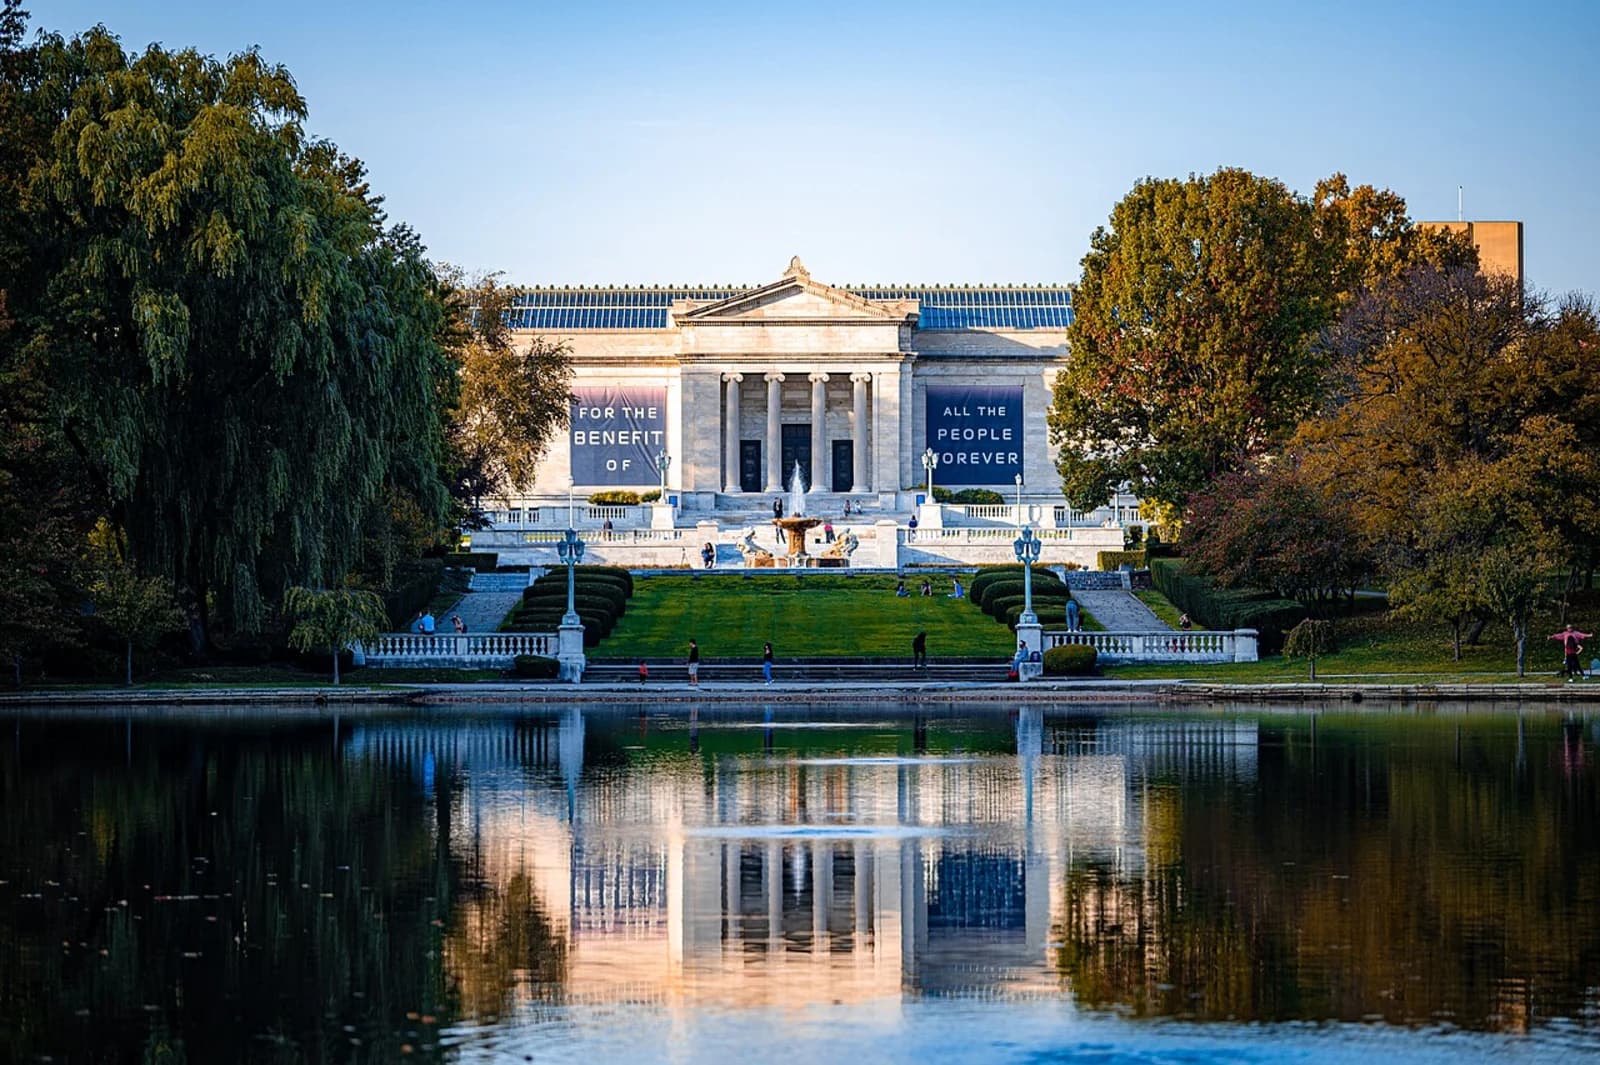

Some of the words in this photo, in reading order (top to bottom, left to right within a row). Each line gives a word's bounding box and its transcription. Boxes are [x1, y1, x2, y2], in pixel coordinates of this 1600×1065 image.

[579, 407, 615, 419] FOR
[622, 407, 657, 419] THE
[943, 406, 971, 416] ALL
[977, 406, 1006, 416] THE
[574, 431, 664, 445] BENEFIT
[937, 428, 1013, 441] PEOPLE
[935, 452, 1019, 465] OREVER
[606, 459, 632, 471] OF
